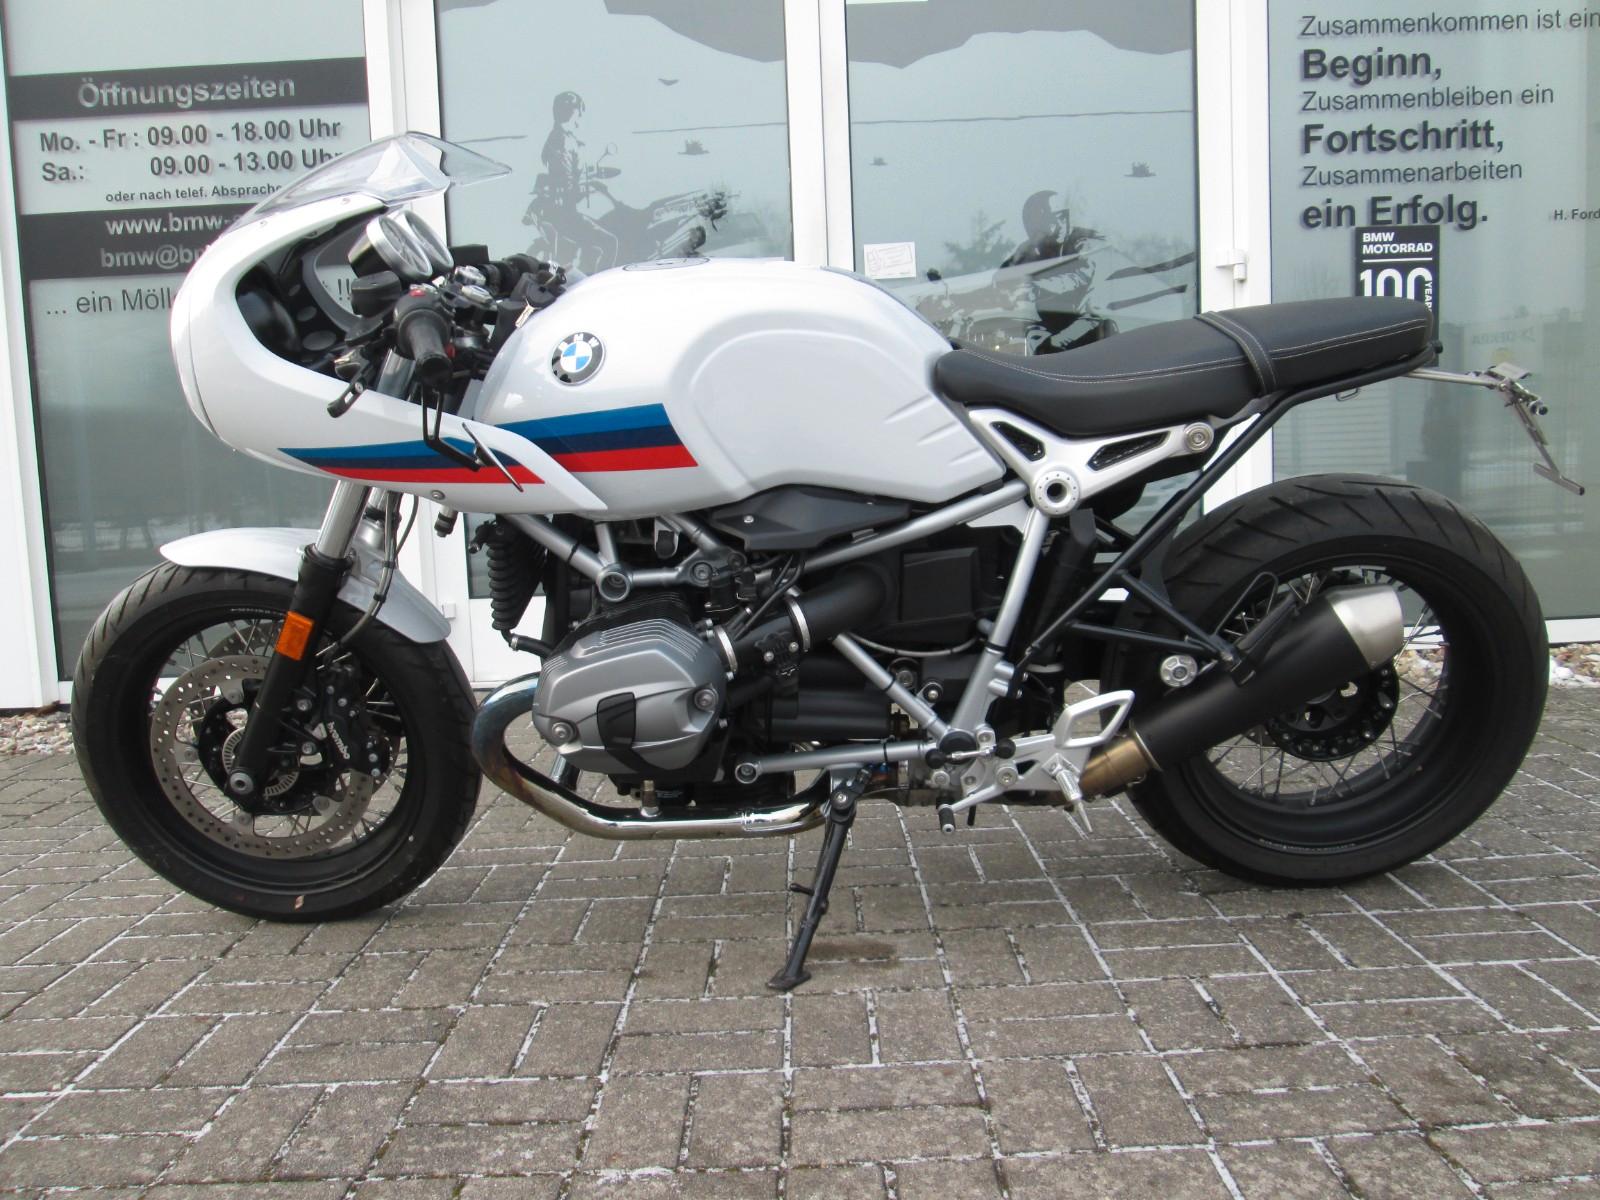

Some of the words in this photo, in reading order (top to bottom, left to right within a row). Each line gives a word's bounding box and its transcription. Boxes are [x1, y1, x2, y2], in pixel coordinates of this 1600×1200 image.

[1300, 12, 1528, 36] Zusammenkommen
[1537, 9, 1561, 29] ist
[1570, 8, 1600, 28] ein
[1302, 46, 1442, 85] Beginn,
[78, 75, 295, 109] Öffnungszeiten
[1302, 85, 1513, 111] Zusammenbleiben
[1521, 84, 1554, 104] ein
[40, 132, 80, 152] Mo.
[148, 124, 207, 147] 09.00
[231, 120, 291, 142] 18.00
[299, 118, 341, 138] Uhr
[1303, 119, 1503, 154] Fortschritt,
[150, 154, 210, 176] 09.00
[233, 150, 293, 172] 13.00
[1302, 160, 1523, 186] Zusammenarbeiten
[105, 191, 136, 202] oder
[139, 187, 172, 201] nach
[175, 188, 207, 199] telef.
[1302, 198, 1356, 229] ein
[1370, 194, 1488, 231] Erfolg.
[1554, 209, 1568, 220] H.
[1571, 207, 1600, 220] Ford
[1362, 232, 1395, 242] BMW
[1362, 242, 1433, 254] MOTORRAD
[76, 291, 113, 314] ein
[1424, 281, 1433, 312] YEAR
[327, 722, 350, 760] brembo
